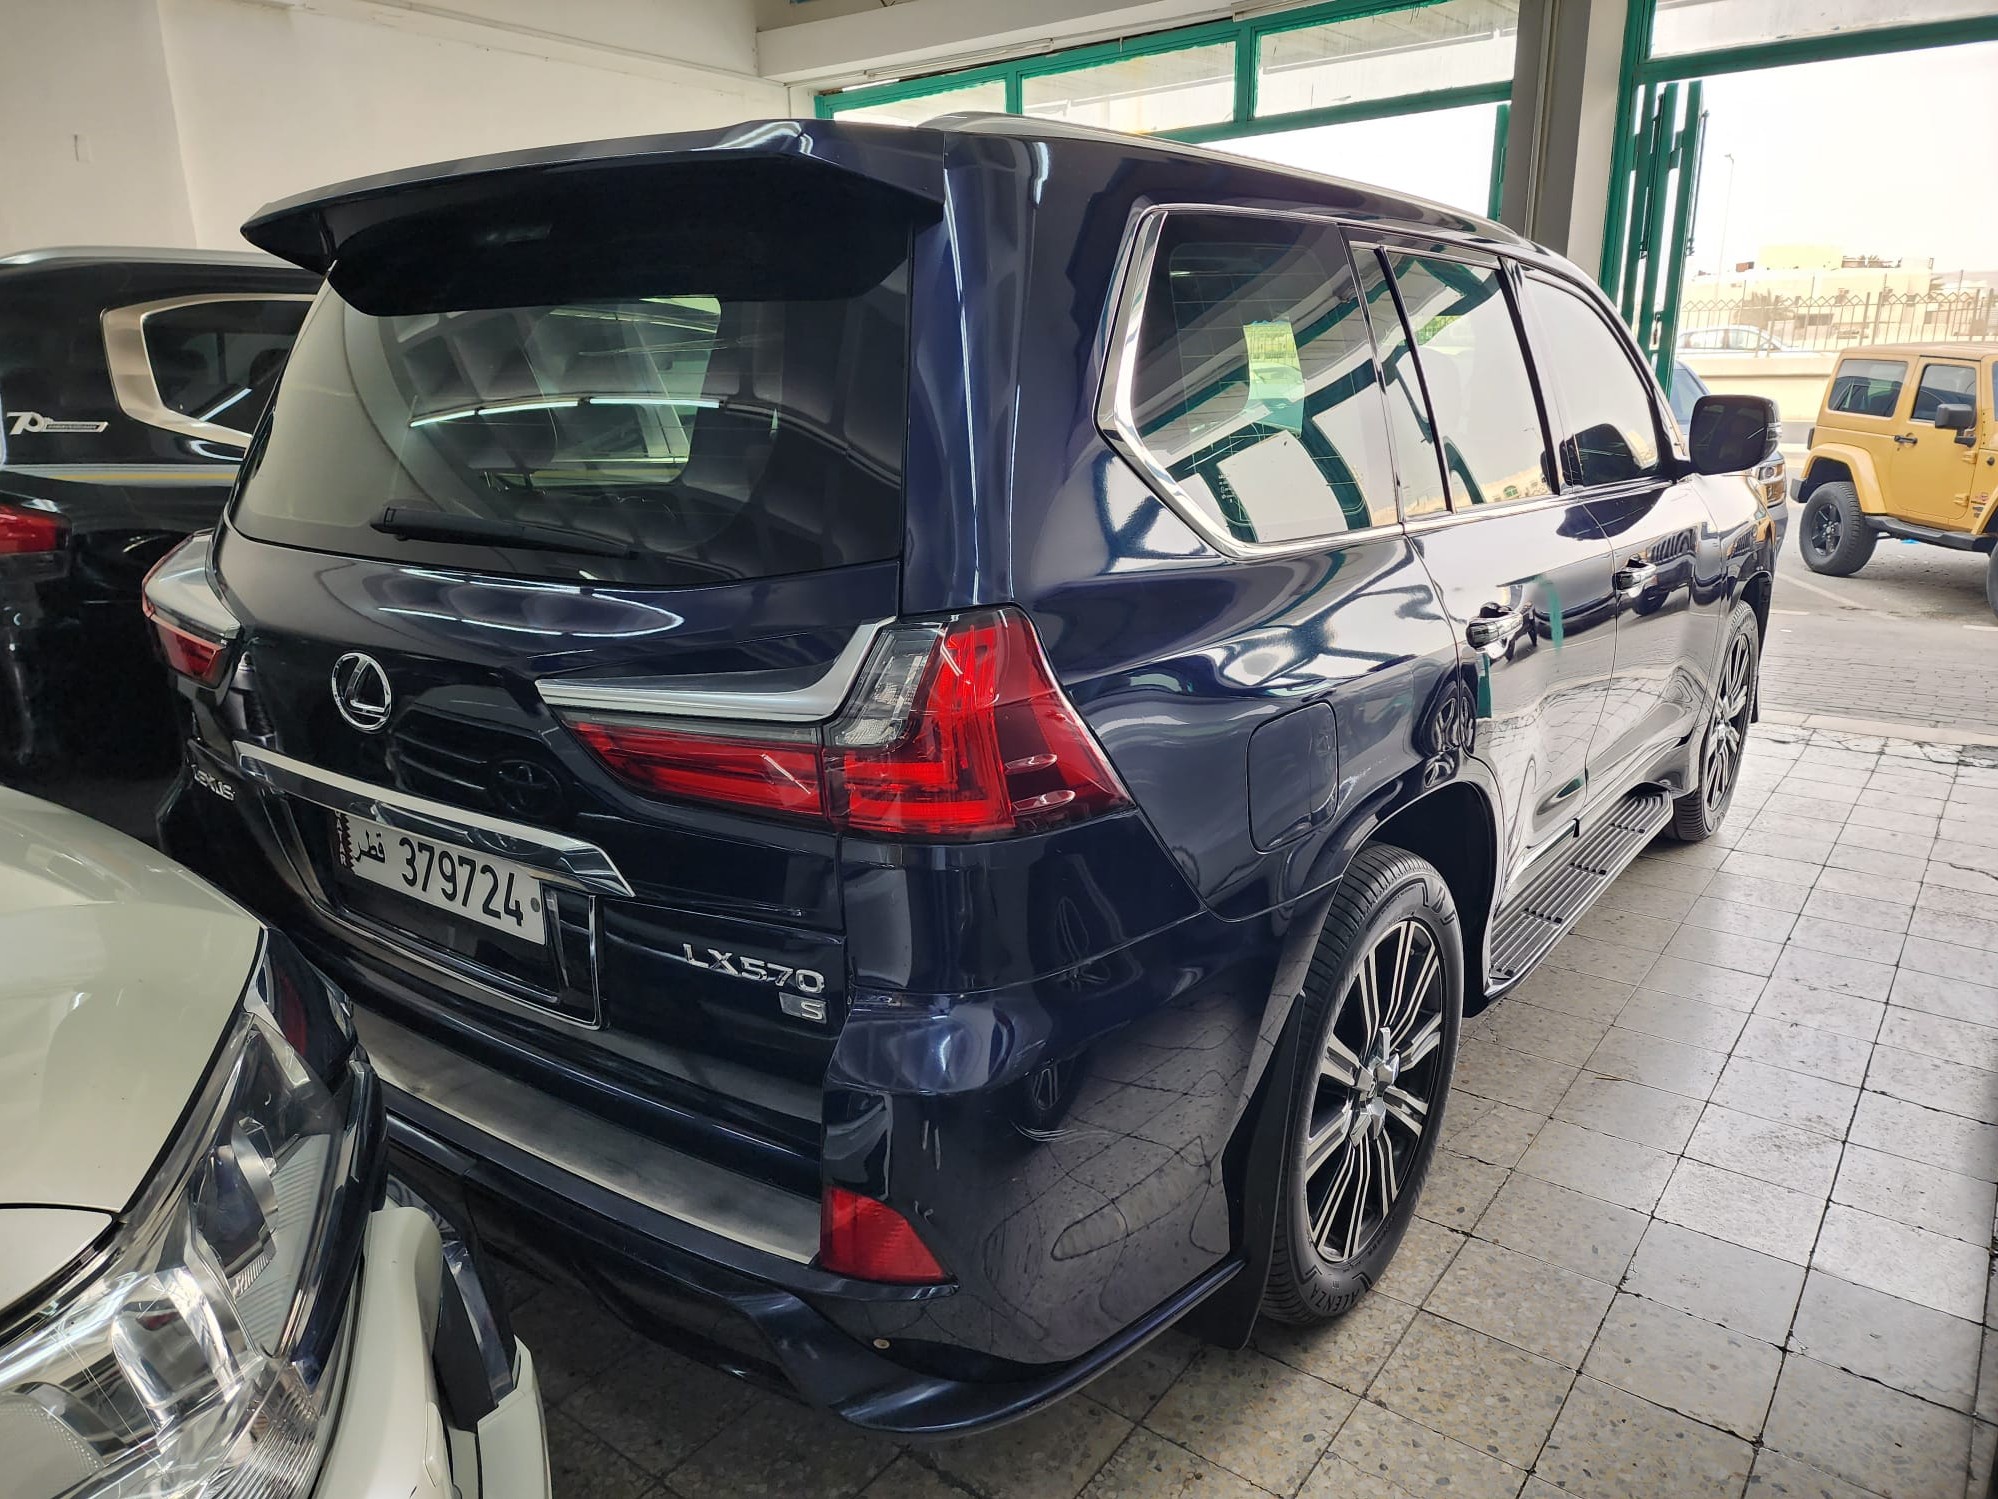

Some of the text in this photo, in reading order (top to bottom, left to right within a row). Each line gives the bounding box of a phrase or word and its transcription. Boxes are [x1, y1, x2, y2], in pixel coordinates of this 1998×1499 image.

[191, 764, 236, 801] LEXUS
[355, 829, 386, 864] قطر
[399, 837, 523, 926] 379724
